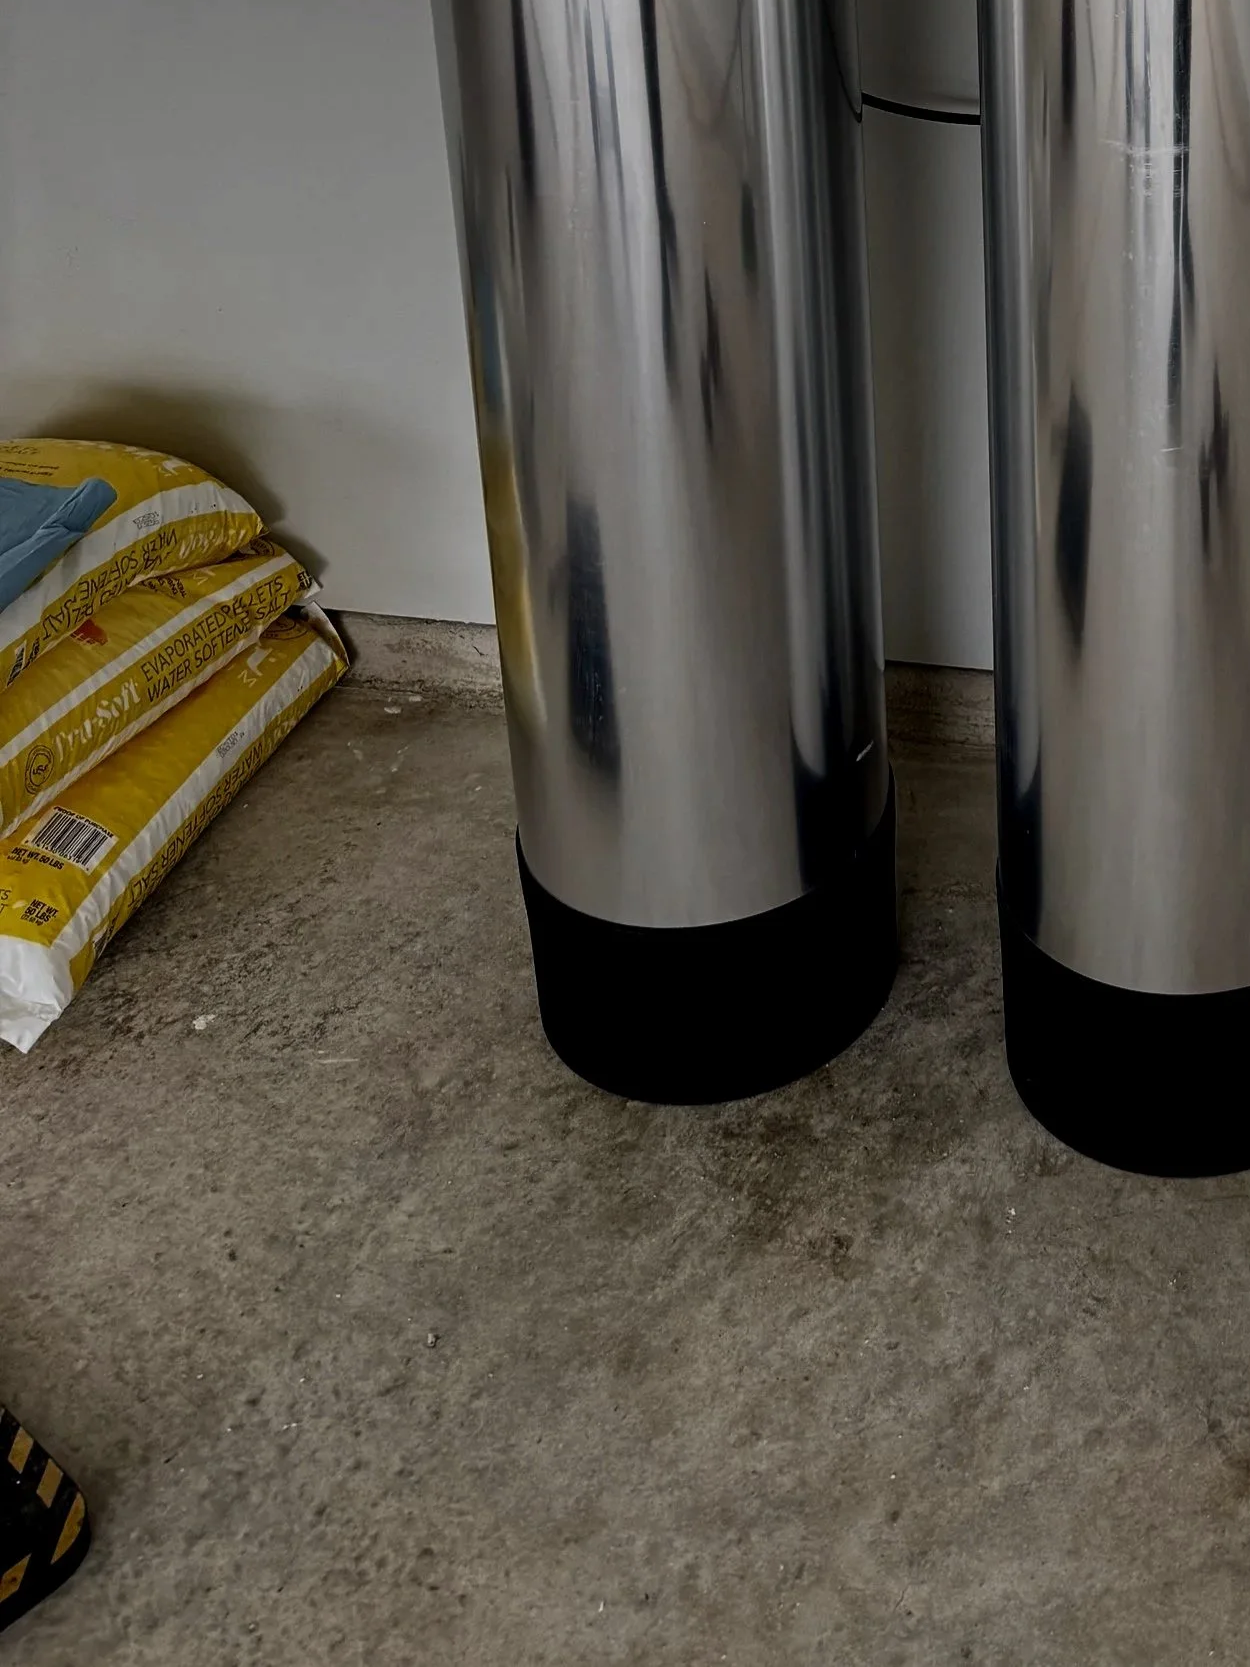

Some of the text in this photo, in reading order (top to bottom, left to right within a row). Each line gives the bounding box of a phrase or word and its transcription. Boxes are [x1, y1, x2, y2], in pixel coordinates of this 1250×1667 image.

[140, 611, 227, 682] EVAPORATED
[147, 662, 192, 702] WATER
[255, 591, 292, 621] SALT
[222, 744, 264, 795] WATER
[54, 806, 75, 817] PROOF
[84, 819, 114, 838] PURCHASE
[160, 787, 222, 862] SOFTENER
[11, 847, 27, 858] NET
[49, 859, 65, 870] LBS
[30, 899, 46, 911] NET
[127, 861, 159, 906] SALT
[35, 910, 51, 922] LBS
